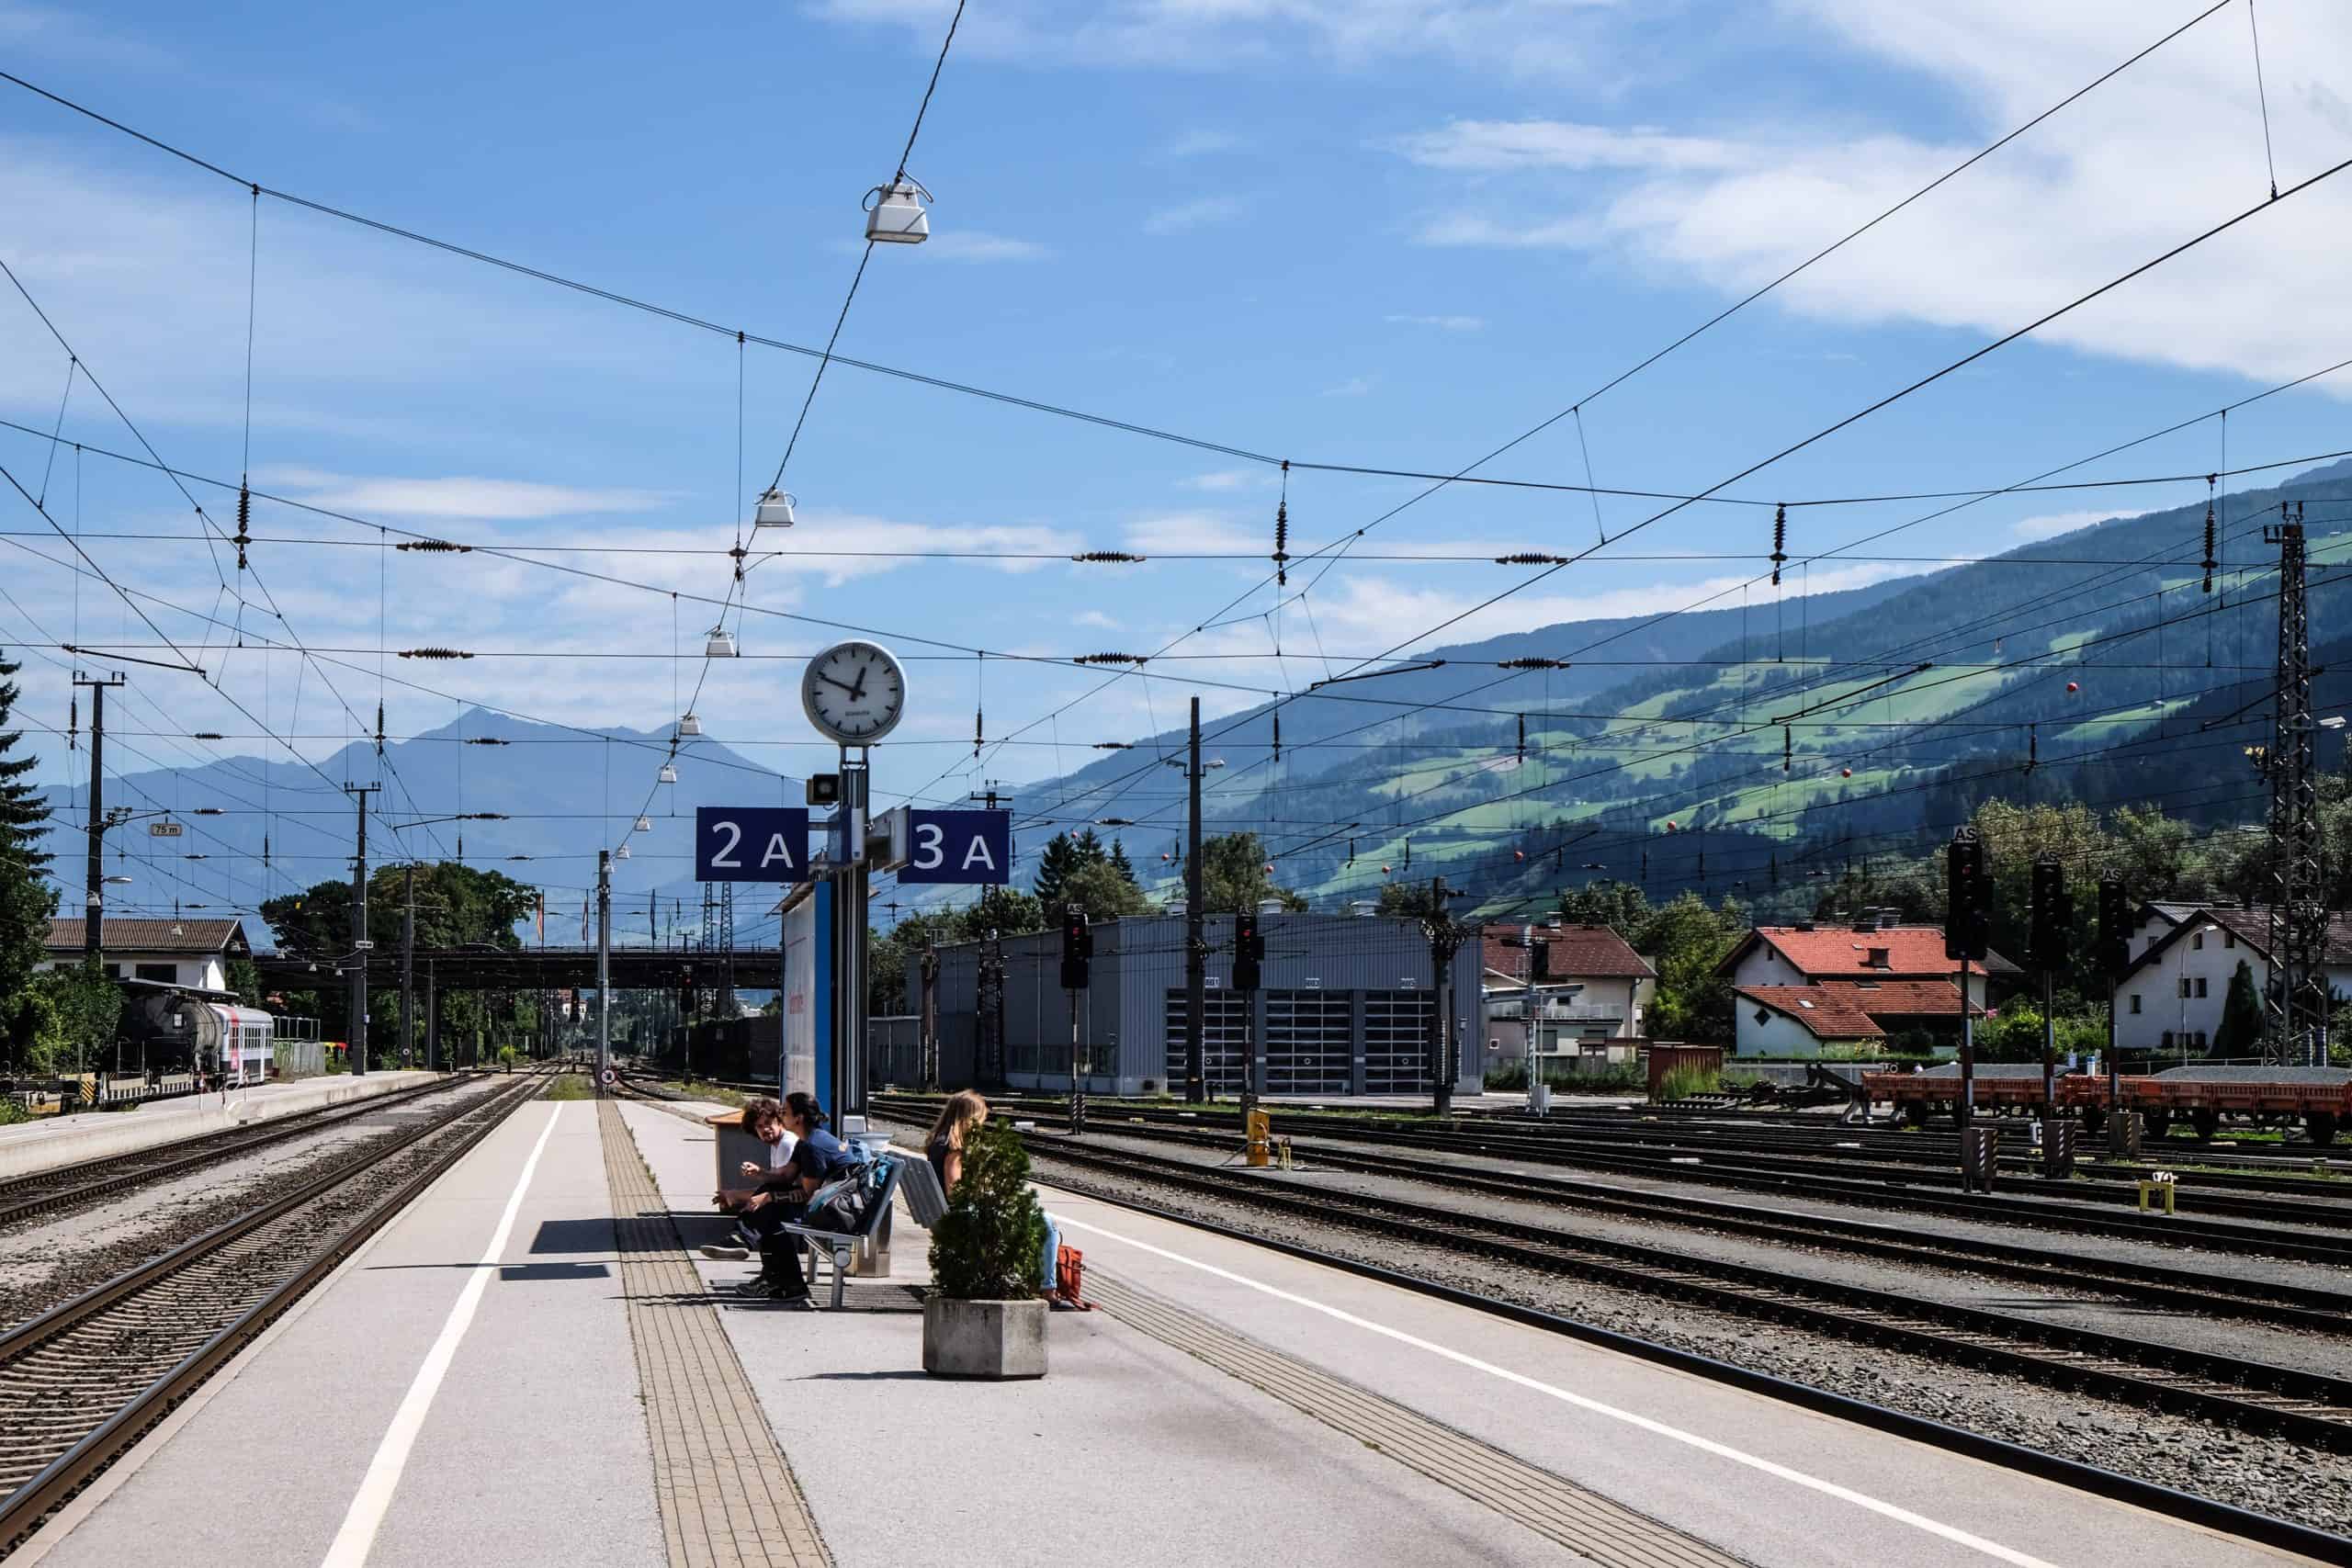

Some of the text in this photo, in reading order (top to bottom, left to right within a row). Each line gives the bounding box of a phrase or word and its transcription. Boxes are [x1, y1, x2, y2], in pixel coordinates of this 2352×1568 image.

[155, 825, 167, 833] 75
[1955, 828, 1976, 840] AS
[711, 821, 794, 868] 2 A
[913, 823, 995, 870] 3 A
[2039, 851, 2058, 862] AS
[2104, 868, 2122, 880] AS
